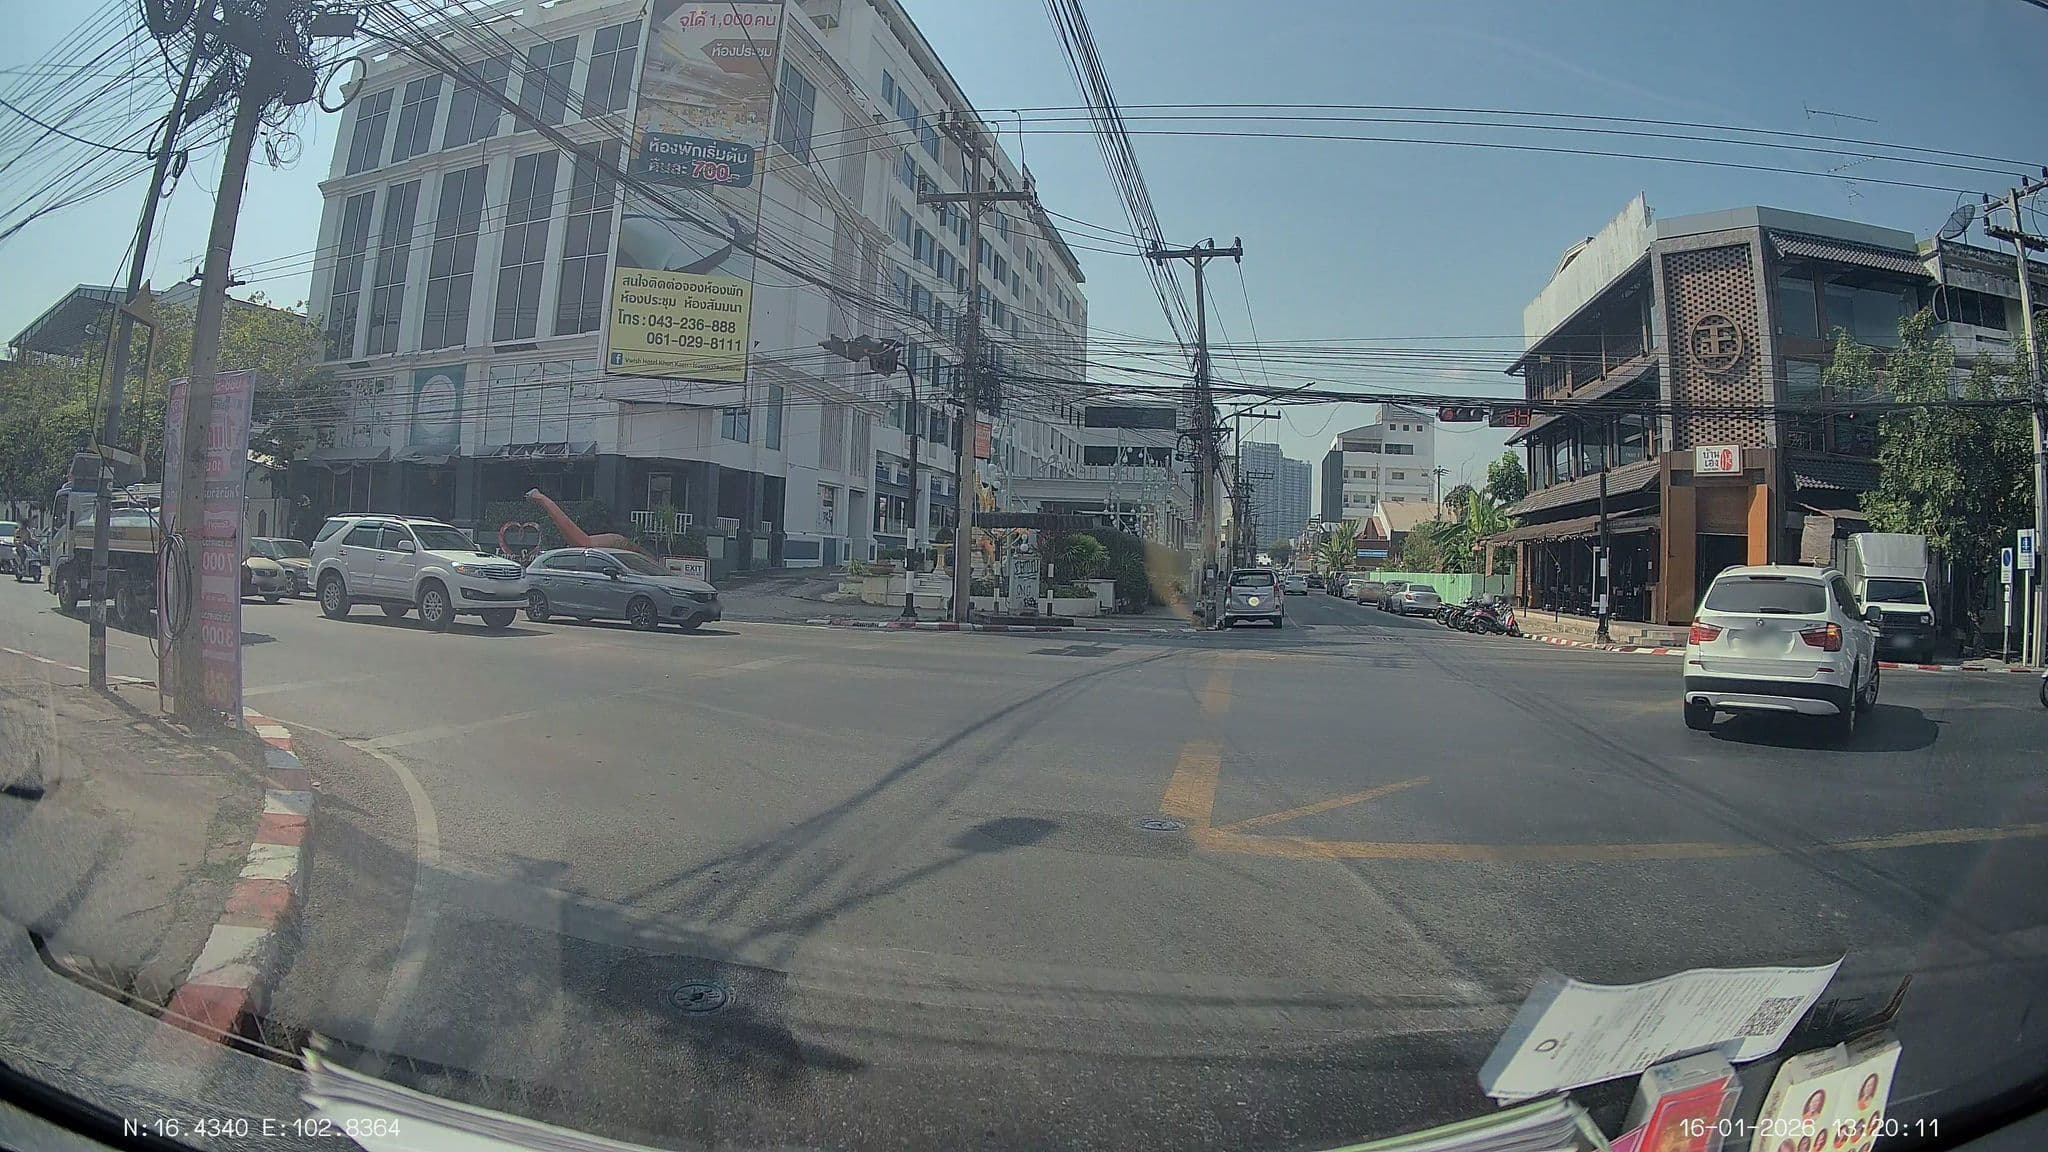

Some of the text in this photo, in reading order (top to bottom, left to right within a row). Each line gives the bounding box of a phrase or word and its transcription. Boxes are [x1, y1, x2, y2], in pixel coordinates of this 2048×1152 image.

[679, 9, 777, 33] จุได้ 1,000 คน
[711, 43, 774, 60] ห้องประชุม
[648, 136, 748, 164] ห้องพักเริ่มต้น
[622, 273, 744, 297] สนใจติดต่อจองห้องพัก
[620, 290, 742, 314] ห้องประชุม ห้องสัมมนา
[648, 314, 736, 334] 043-236-888
[646, 332, 742, 352] 061-029-8111
[684, 564, 703, 573] EXIT
